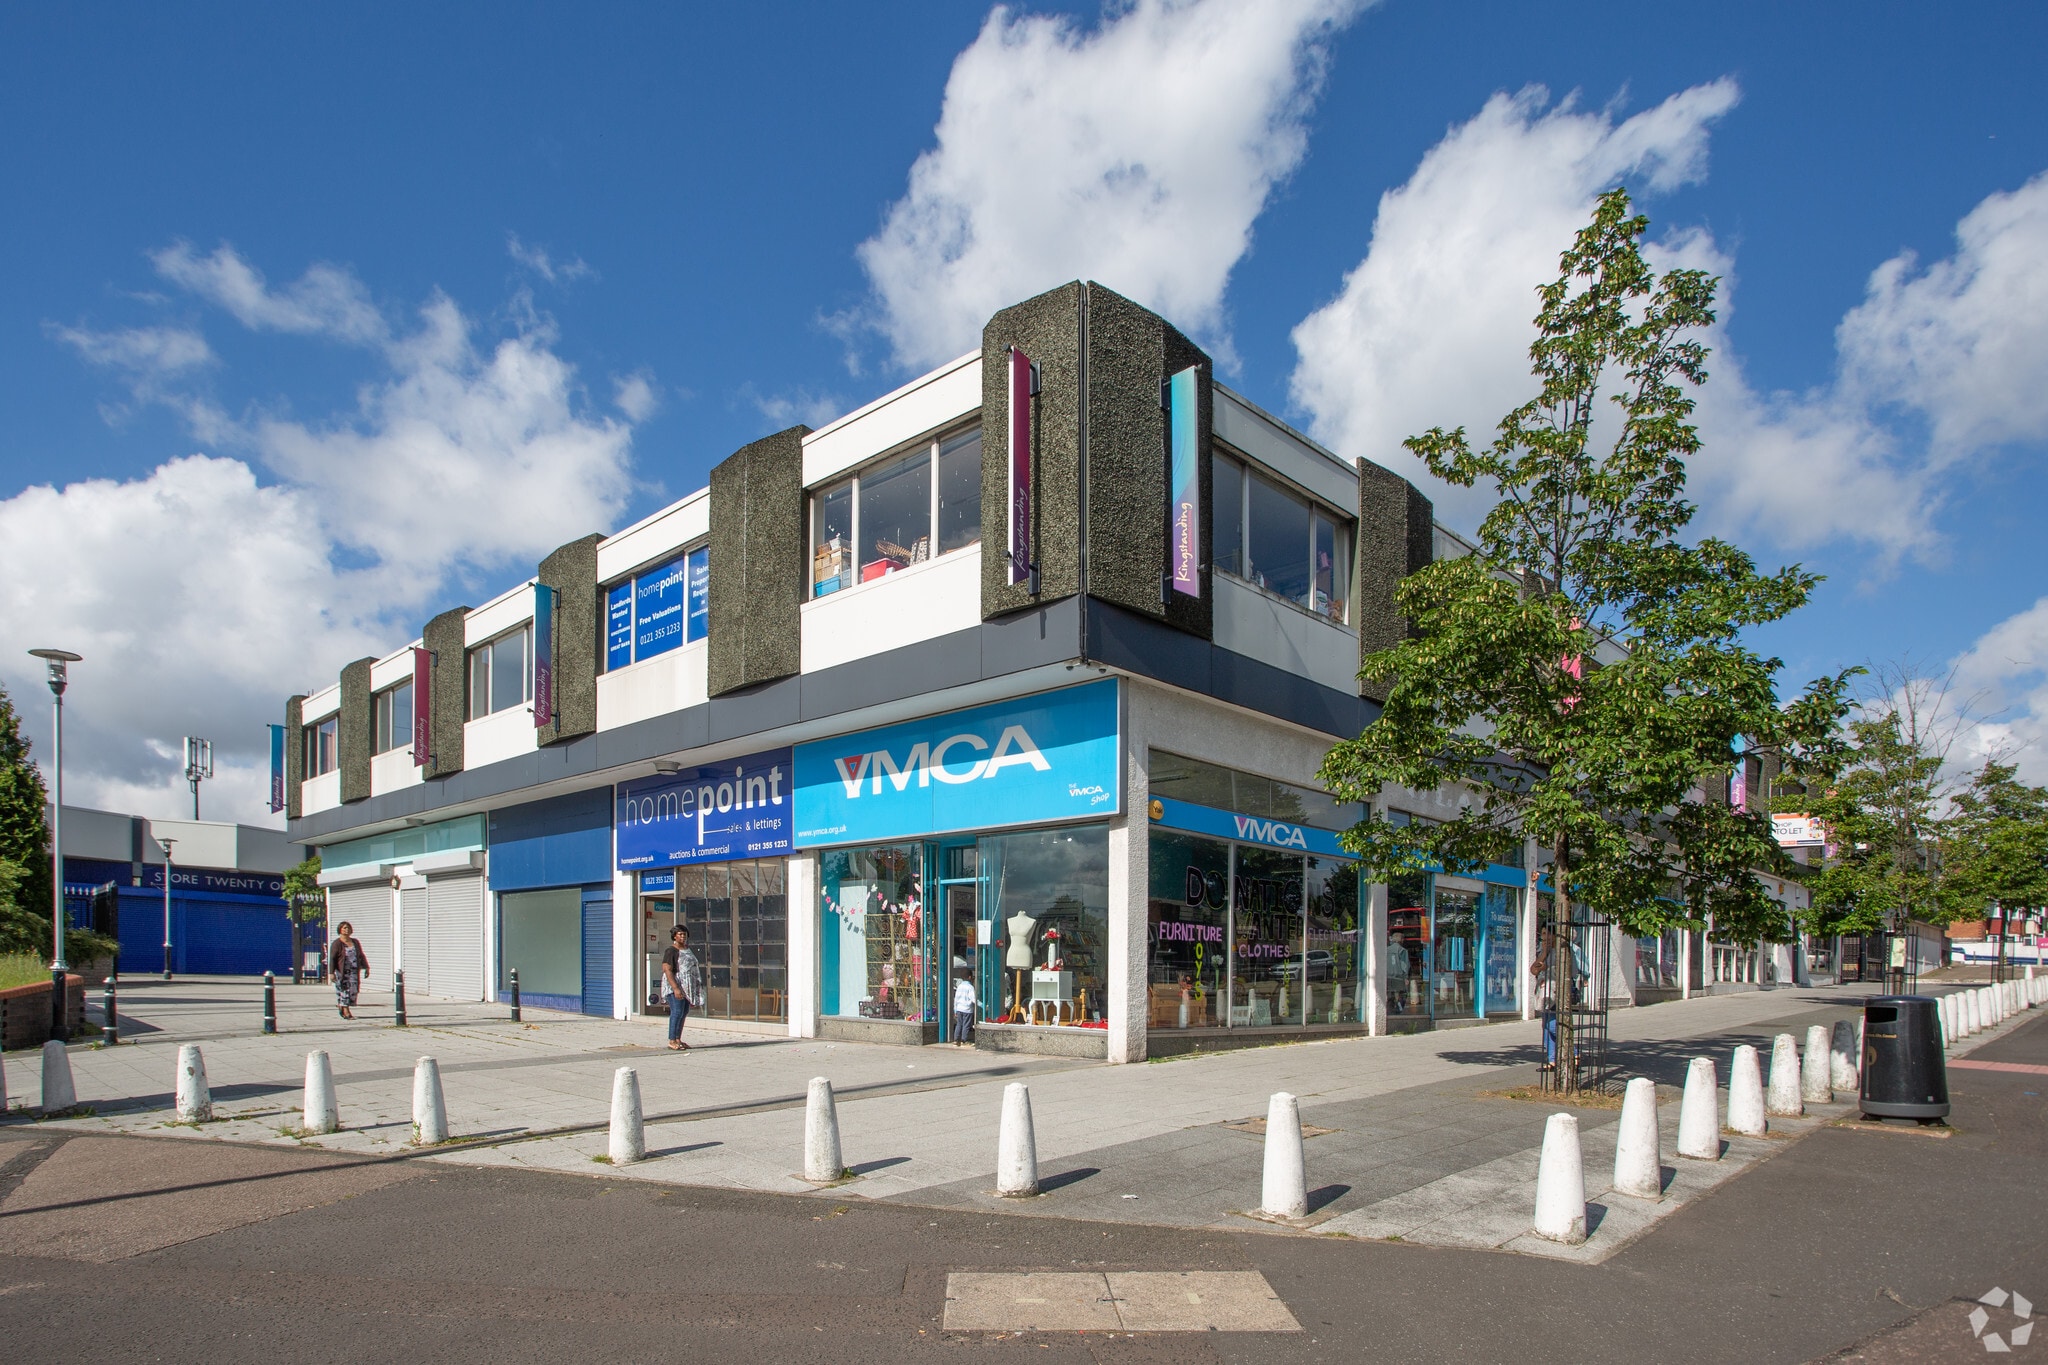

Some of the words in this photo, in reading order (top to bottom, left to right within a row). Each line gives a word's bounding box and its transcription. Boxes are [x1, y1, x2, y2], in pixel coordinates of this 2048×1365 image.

[1014, 487, 1029, 572] Kingstanding
[1175, 503, 1193, 581] Kingstanding
[638, 570, 683, 599] homepoint
[640, 617, 651, 626] Free
[652, 604, 681, 621] Valuations
[640, 631, 653, 645] 0121
[655, 627, 665, 640] 355
[667, 622, 681, 636] 1233
[536, 668, 550, 719] Kingstanding
[415, 717, 428, 760] Kingstanding
[834, 724, 1052, 799] YMCA
[1069, 786, 1103, 797] YMCA
[1091, 793, 1110, 806] Shop
[625, 765, 783, 845] homepoint
[745, 821, 751, 831] &
[753, 817, 782, 830] lettings
[798, 824, 847, 839] www.ymca.org.uk
[1233, 815, 1308, 849] YMCA
[1789, 827, 1804, 835] LET
[669, 847, 691, 860] auctions
[691, 849, 697, 858] &
[697, 844, 730, 857] commercial
[748, 843, 761, 851] 0121
[762, 841, 773, 850] 355
[774, 840, 788, 849] 1233
[621, 854, 654, 865] homepoint.org.uk
[154, 872, 199, 885] SORE
[205, 875, 265, 889] TWENTY
[1159, 921, 1223, 943] FURNITURE
[1238, 943, 1291, 958] CLOTHES
